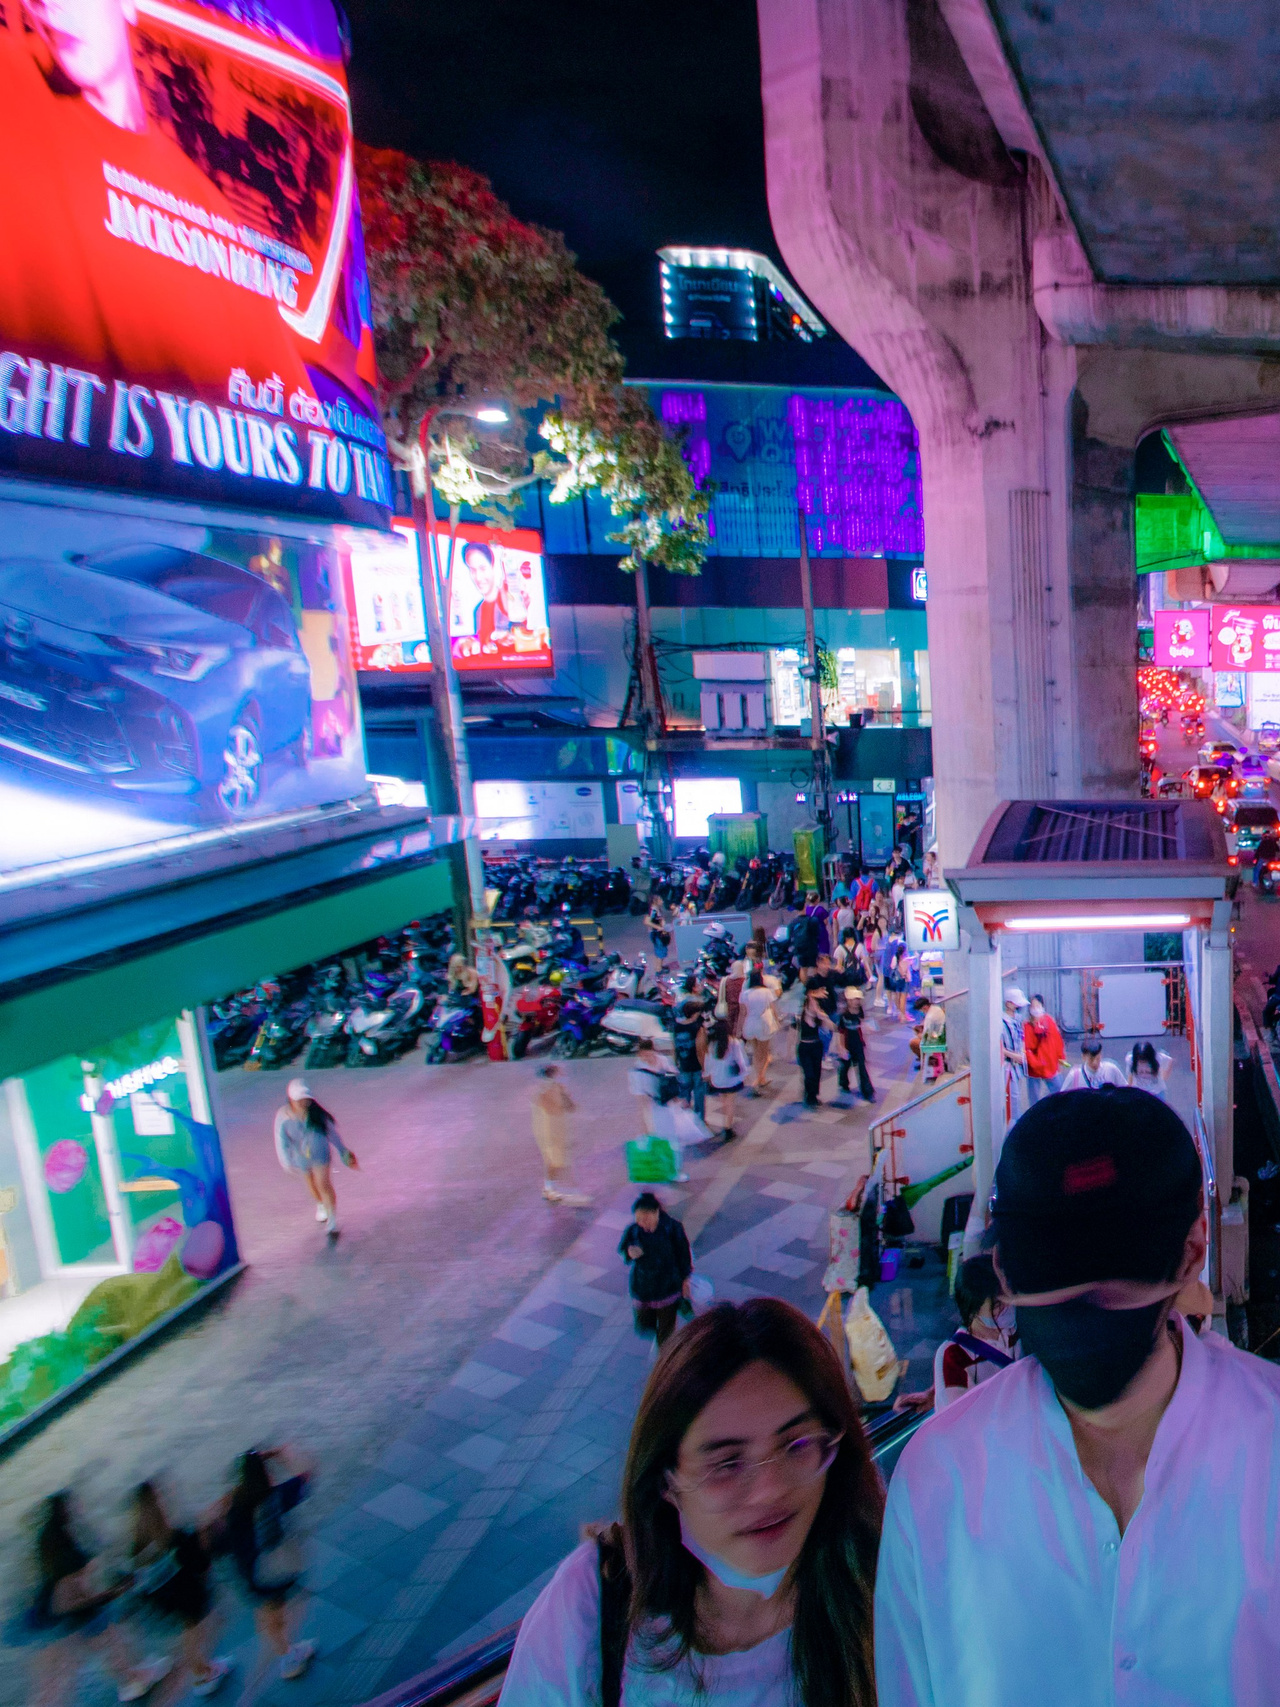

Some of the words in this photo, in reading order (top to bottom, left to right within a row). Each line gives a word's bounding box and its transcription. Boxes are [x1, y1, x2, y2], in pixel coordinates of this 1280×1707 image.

[108, 379, 156, 458] IS
[155, 389, 303, 487] YOURS
[308, 430, 351, 496] TO
